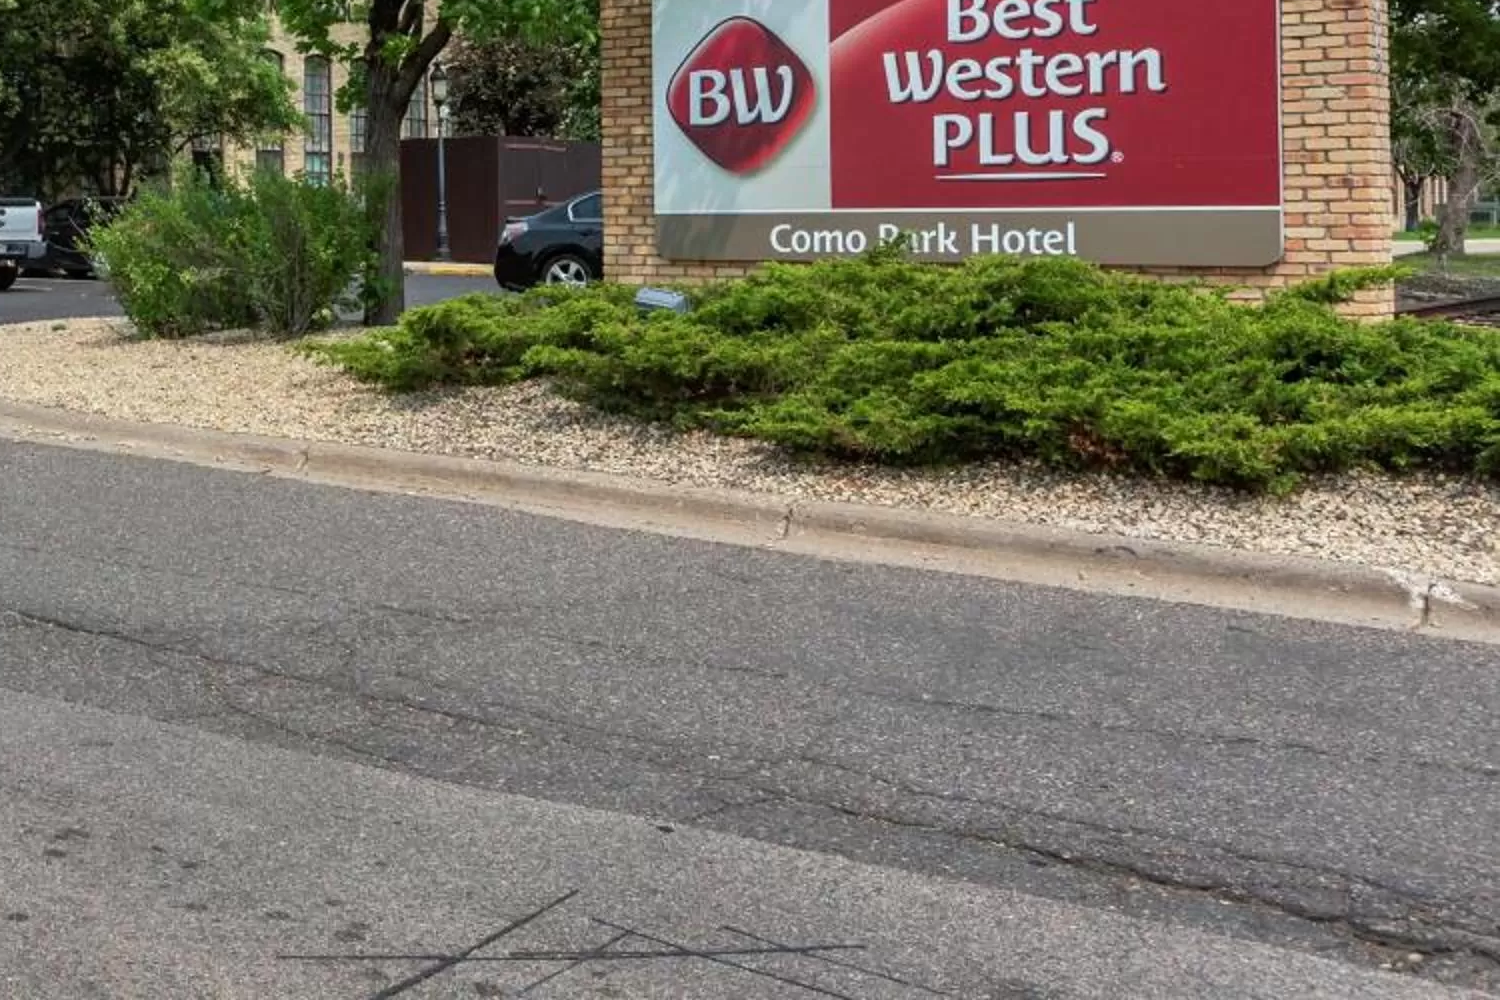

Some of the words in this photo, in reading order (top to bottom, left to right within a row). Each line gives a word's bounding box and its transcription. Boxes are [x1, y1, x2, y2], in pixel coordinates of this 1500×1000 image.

[688, 65, 794, 127] BW
[882, 47, 1167, 104] Western
[769, 223, 867, 255] Como
[970, 221, 1077, 255] Hotel
